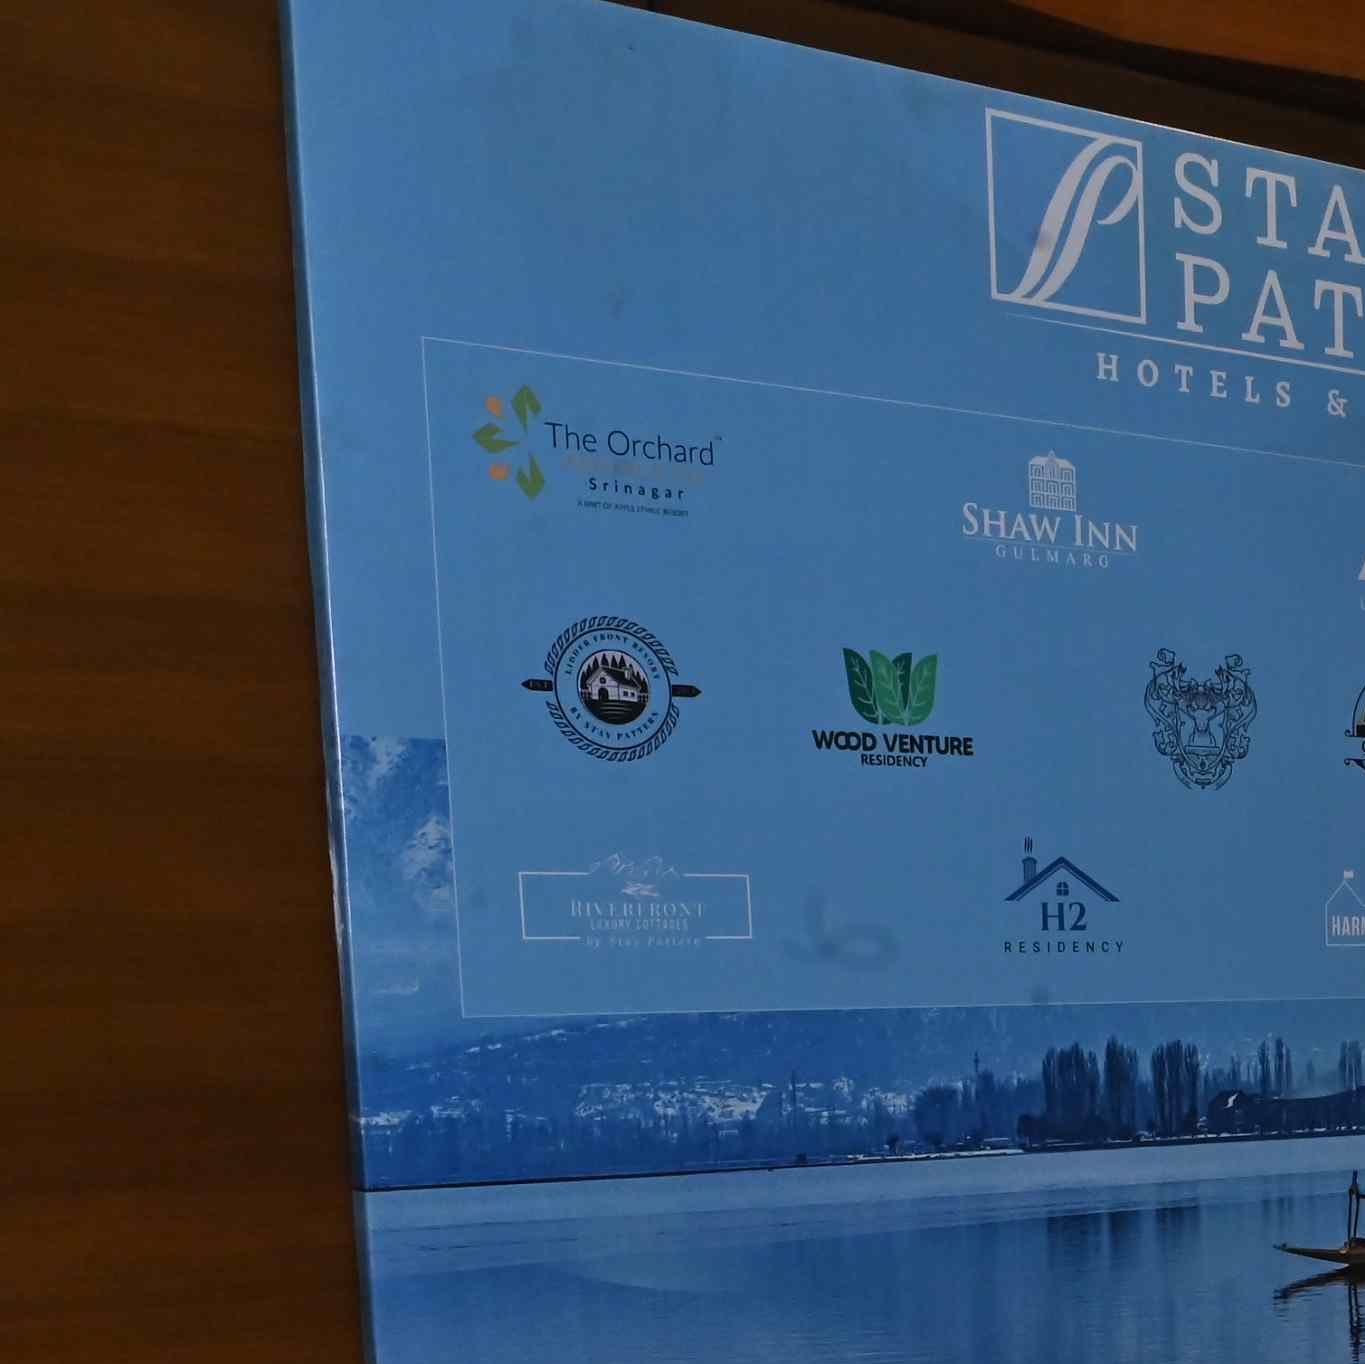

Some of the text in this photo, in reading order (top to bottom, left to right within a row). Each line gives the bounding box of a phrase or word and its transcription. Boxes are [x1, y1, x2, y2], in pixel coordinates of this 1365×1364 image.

[1096, 352, 1292, 409] HOTELS
[1327, 389, 1348, 418] &
[544, 422, 714, 466] The Orchard
[588, 477, 684, 500] Srinagar
[962, 502, 1138, 552] SHAW INN
[995, 544, 1110, 568] GULMARG
[812, 730, 975, 757] WOOD VENTURE
[861, 754, 929, 769] RESIDENCY
[1041, 902, 1088, 931] H2
[1004, 941, 1124, 953] RESIDENCY
